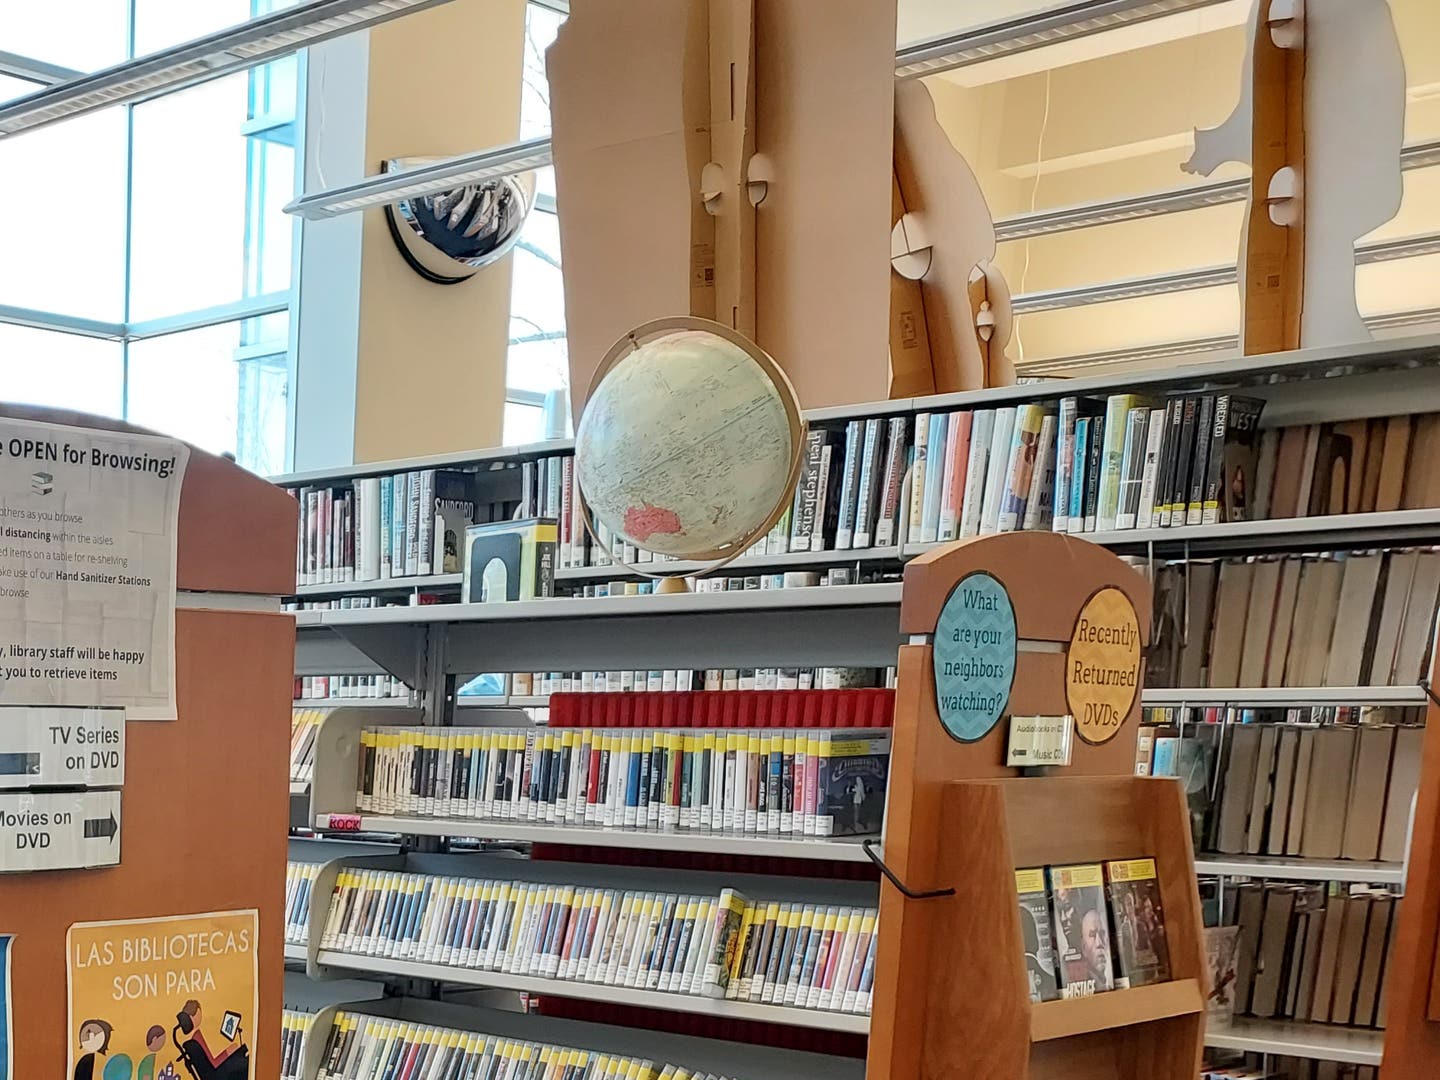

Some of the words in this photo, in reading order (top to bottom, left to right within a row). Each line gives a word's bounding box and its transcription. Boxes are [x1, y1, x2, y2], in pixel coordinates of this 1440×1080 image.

[10, 438, 58, 462] OPEN
[63, 444, 86, 465] for
[91, 448, 176, 479] Browsing!
[0, 506, 26, 519] others
[27, 511, 37, 520] as
[37, 511, 53, 523] you
[55, 511, 83, 524] browse
[5, 526, 51, 543] distancing
[52, 531, 76, 542] within
[77, 533, 91, 544] the
[92, 534, 114, 546] aisles
[9, 546, 33, 559] items
[34, 551, 45, 560] on
[52, 550, 73, 562] table
[74, 552, 86, 563] for
[87, 554, 128, 568] re-shelving
[13, 569, 28, 579] use
[29, 568, 40, 580] of
[40, 571, 54, 580] our
[55, 570, 79, 582] Hand
[80, 572, 117, 585] Sanitizer
[117, 574, 152, 587] Stations
[0, 586, 30, 599] browse
[962, 588, 999, 611] What
[952, 627, 972, 645] are
[972, 630, 1002, 649] your
[1077, 618, 1138, 653] Recently
[9, 645, 48, 661] library
[49, 646, 76, 660] staff
[77, 647, 96, 660] will
[98, 648, 111, 661] be
[112, 648, 145, 665] happy
[5, 666, 27, 681] you
[29, 666, 41, 679] to
[44, 667, 88, 680] retrieve
[89, 667, 118, 681] items
[943, 656, 1005, 682] neighbors
[1072, 660, 1136, 688] Returned
[940, 692, 1003, 716] watching?
[1082, 702, 1119, 728] DVDs
[49, 726, 72, 745] TV
[76, 726, 120, 744] Series
[66, 756, 85, 770] on
[90, 751, 120, 770] DVD
[53, 811, 72, 825] on
[16, 832, 51, 850] DVD
[75, 940, 114, 968] LAS
[121, 928, 250, 964] BIBLIOTECAS
[112, 974, 158, 1000] SON
[164, 966, 216, 995] PARA
